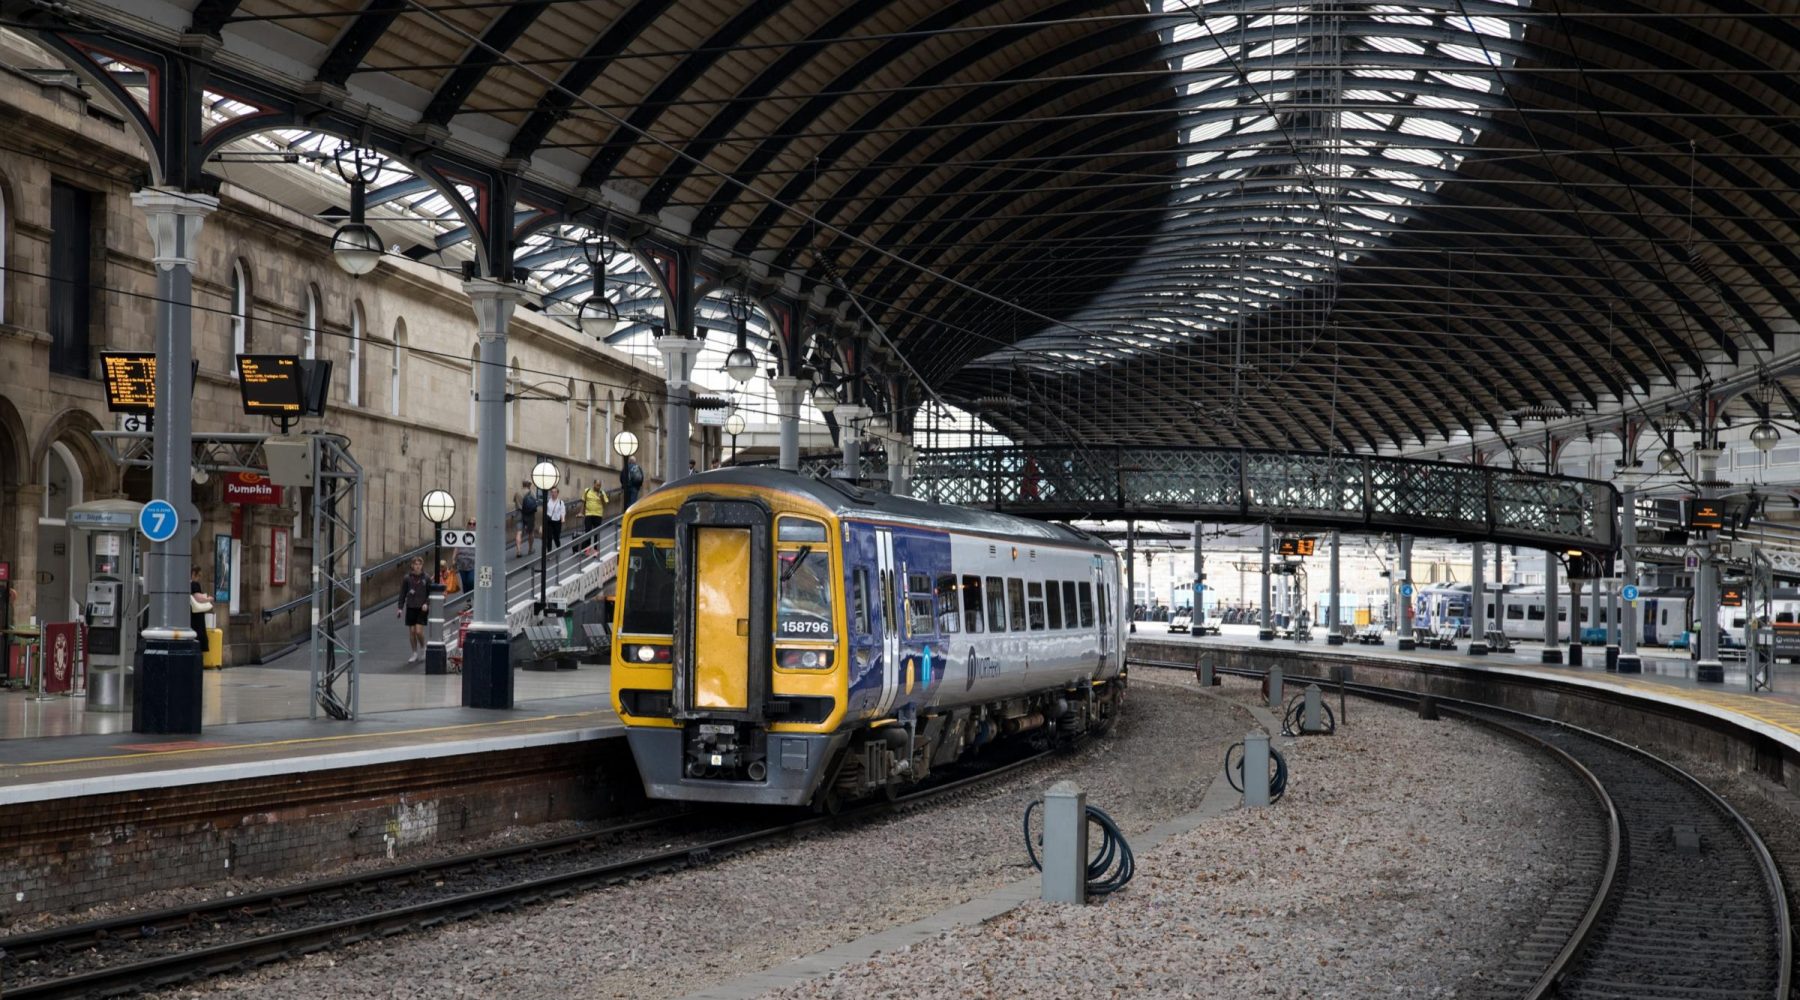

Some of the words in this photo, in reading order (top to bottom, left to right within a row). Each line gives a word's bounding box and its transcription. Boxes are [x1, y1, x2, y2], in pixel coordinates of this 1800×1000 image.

[228, 483, 272, 494] Pumpkin
[152, 513, 165, 533] 7
[1628, 588, 1634, 598] 5
[782, 621, 829, 633] 158796
